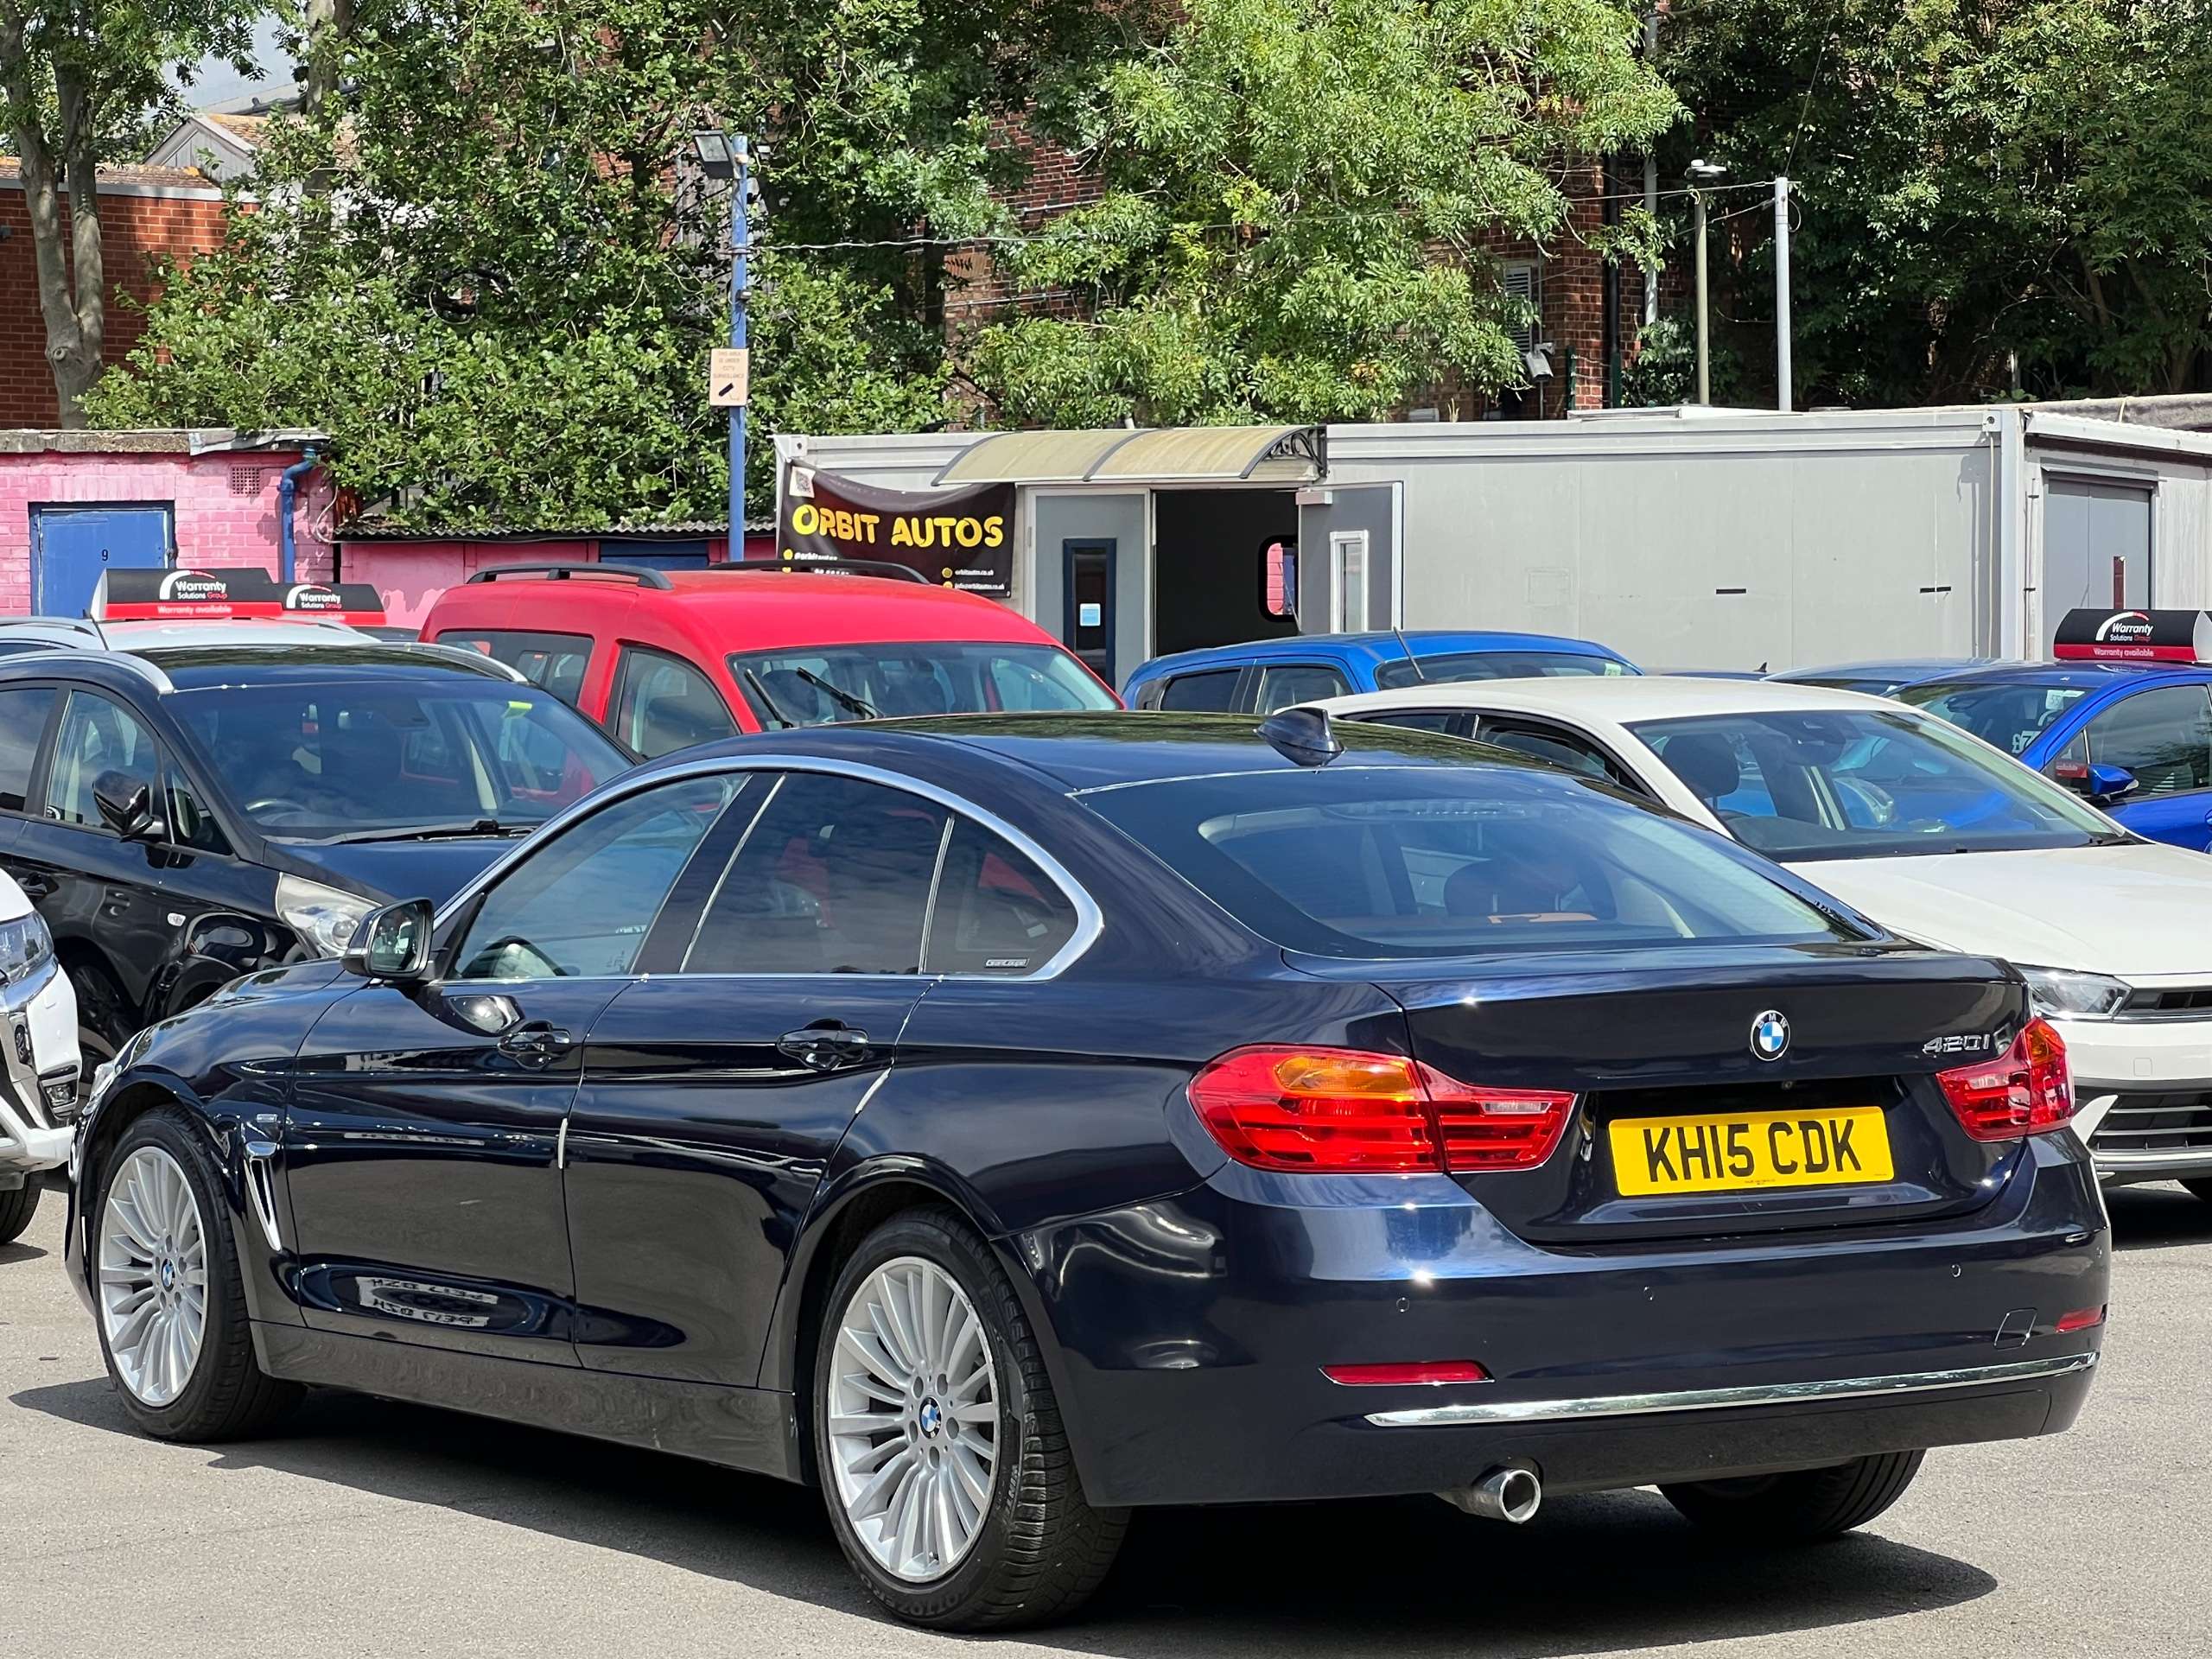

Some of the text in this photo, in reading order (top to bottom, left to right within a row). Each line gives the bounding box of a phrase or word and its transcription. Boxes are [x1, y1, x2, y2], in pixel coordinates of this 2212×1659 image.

[792, 504, 1004, 547] ORBIT AUTOS
[101, 549, 109, 562] 9
[175, 581, 226, 594] Warranty
[299, 592, 341, 605] Warranty
[157, 604, 232, 615] Warranty available
[2112, 622, 2154, 637] Warranty
[2109, 633, 2133, 642] Solutions
[2093, 647, 2154, 658] Warranty available
[1643, 1118, 1862, 1182] KH15 CDK
